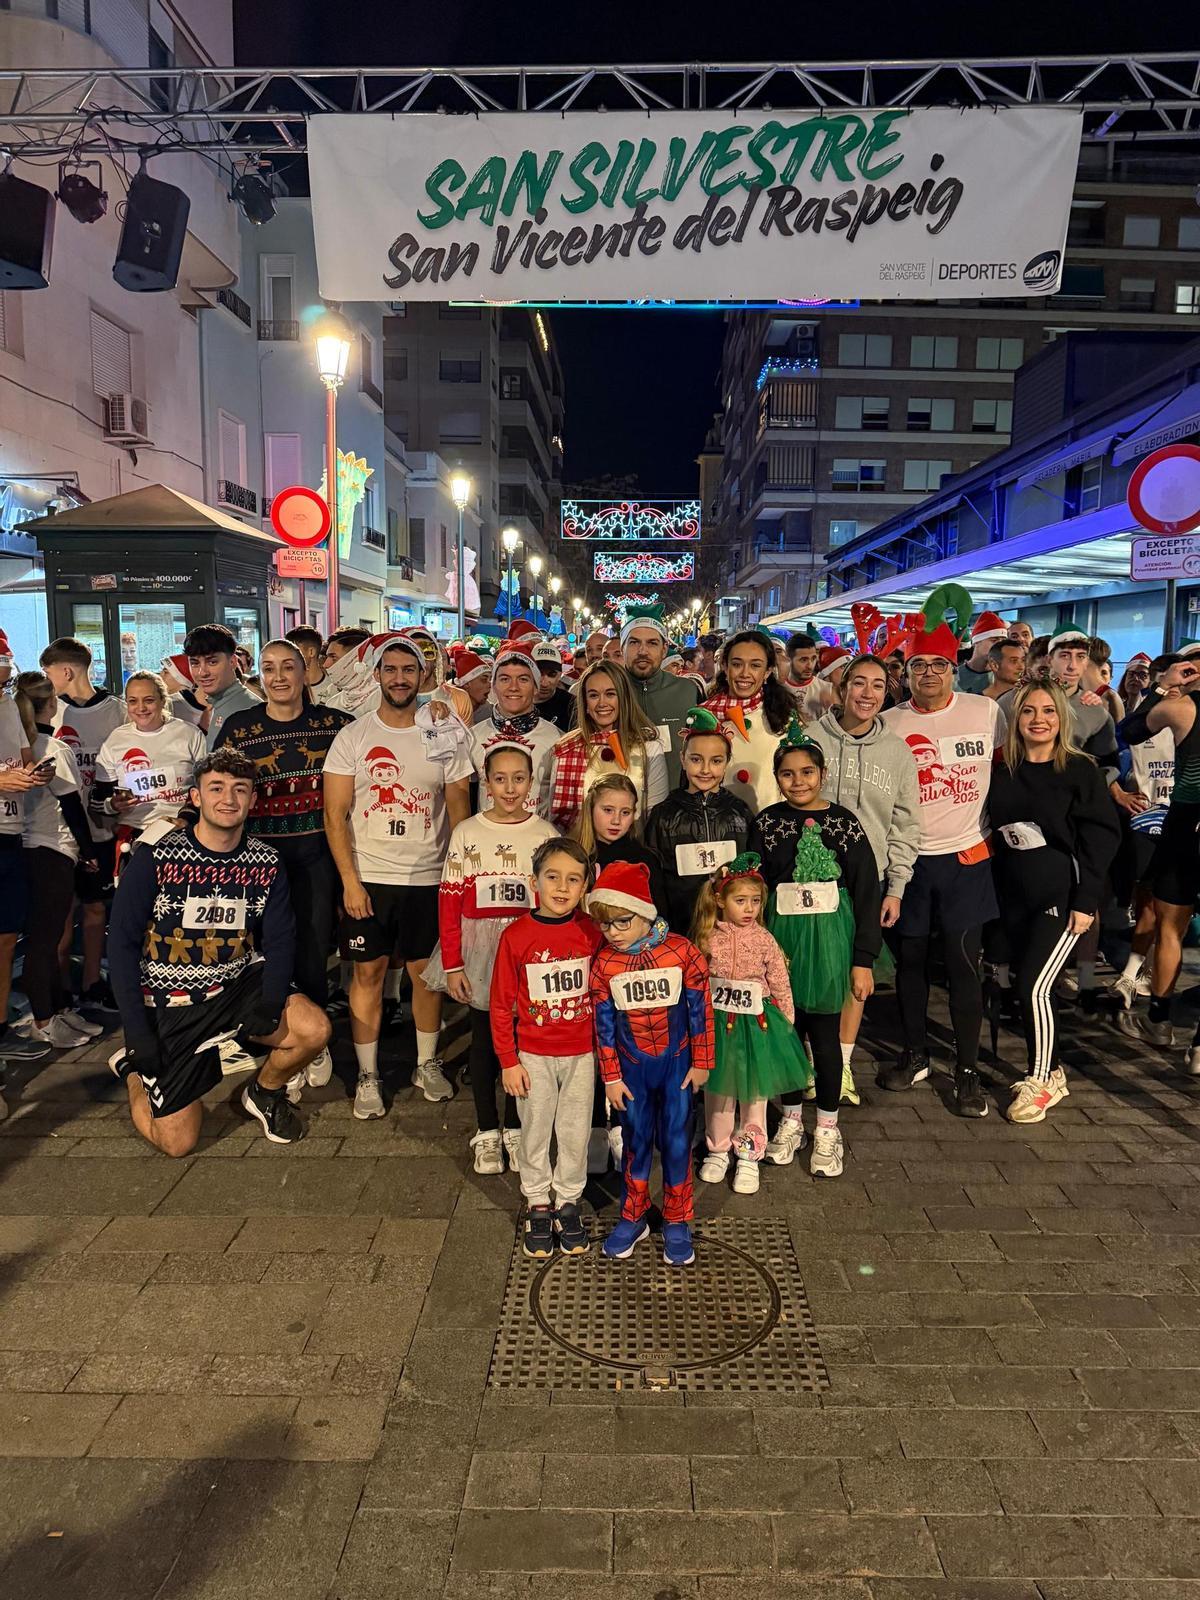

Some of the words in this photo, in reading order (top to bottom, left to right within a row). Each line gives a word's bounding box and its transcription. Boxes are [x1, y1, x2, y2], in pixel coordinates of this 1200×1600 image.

[417, 150, 563, 229] SAN
[560, 109, 912, 215] SILVESTRE
[383, 233, 479, 289] San
[490, 201, 666, 274] Vicente
[673, 183, 762, 252] del
[759, 153, 963, 242] Raspeig
[879, 263, 895, 272] SAN
[896, 263, 926, 271] VICENTE
[879, 271, 894, 280] DEL
[895, 271, 926, 280] RASPEIG
[939, 263, 1017, 280] DEPORTES
[1134, 420, 1199, 455] ELABORACION
[1146, 538, 1194, 549] EXCEPTO
[955, 740, 985, 757] 868
[845, 757, 892, 795] BALBOA
[949, 763, 978, 781] San
[134, 774, 167, 791] 1349
[408, 787, 431, 804] San
[953, 790, 980, 804] 2025
[388, 819, 406, 836] 16
[699, 850, 716, 868] 11
[802, 889, 814, 908] 8
[195, 906, 236, 924] 2498
[542, 968, 583, 993] 1160
[622, 978, 671, 1003] 1099
[713, 986, 753, 1008] 2793
